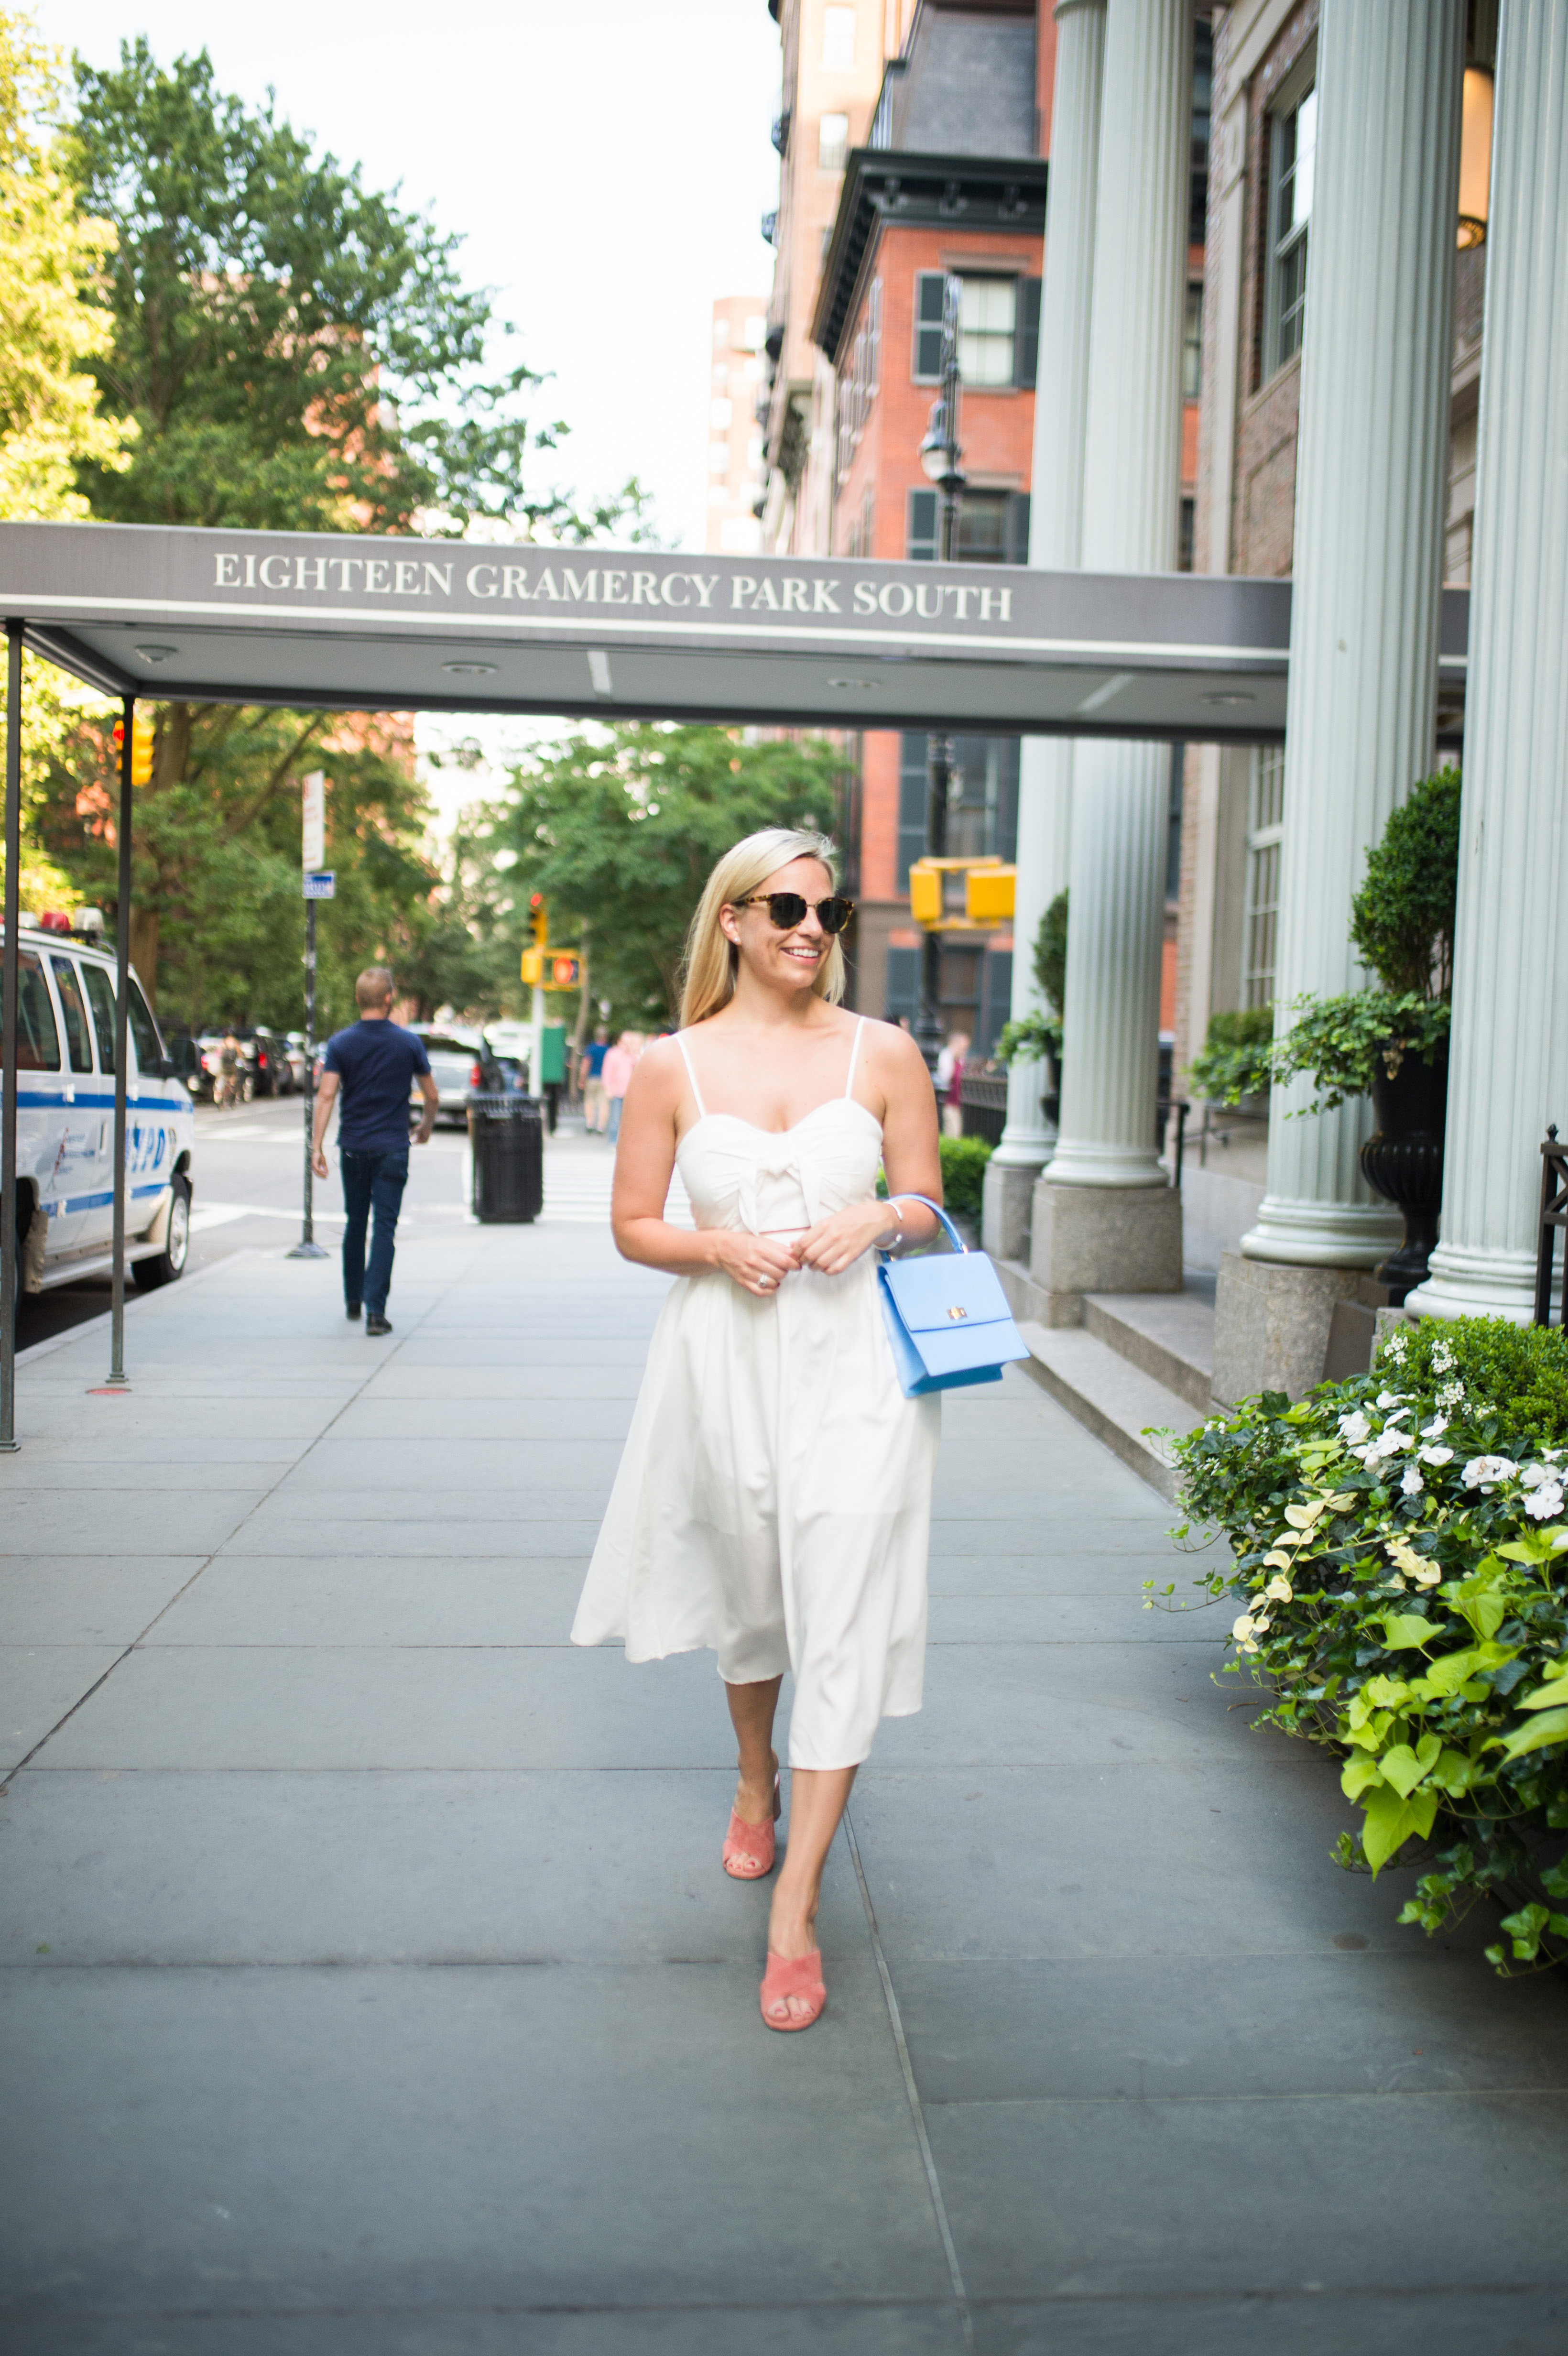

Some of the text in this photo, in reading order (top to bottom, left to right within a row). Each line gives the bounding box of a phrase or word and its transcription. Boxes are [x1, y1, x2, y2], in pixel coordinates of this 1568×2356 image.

[213, 553, 1013, 622] EIGHTEEN GRAMERCY PARK SOUTH
